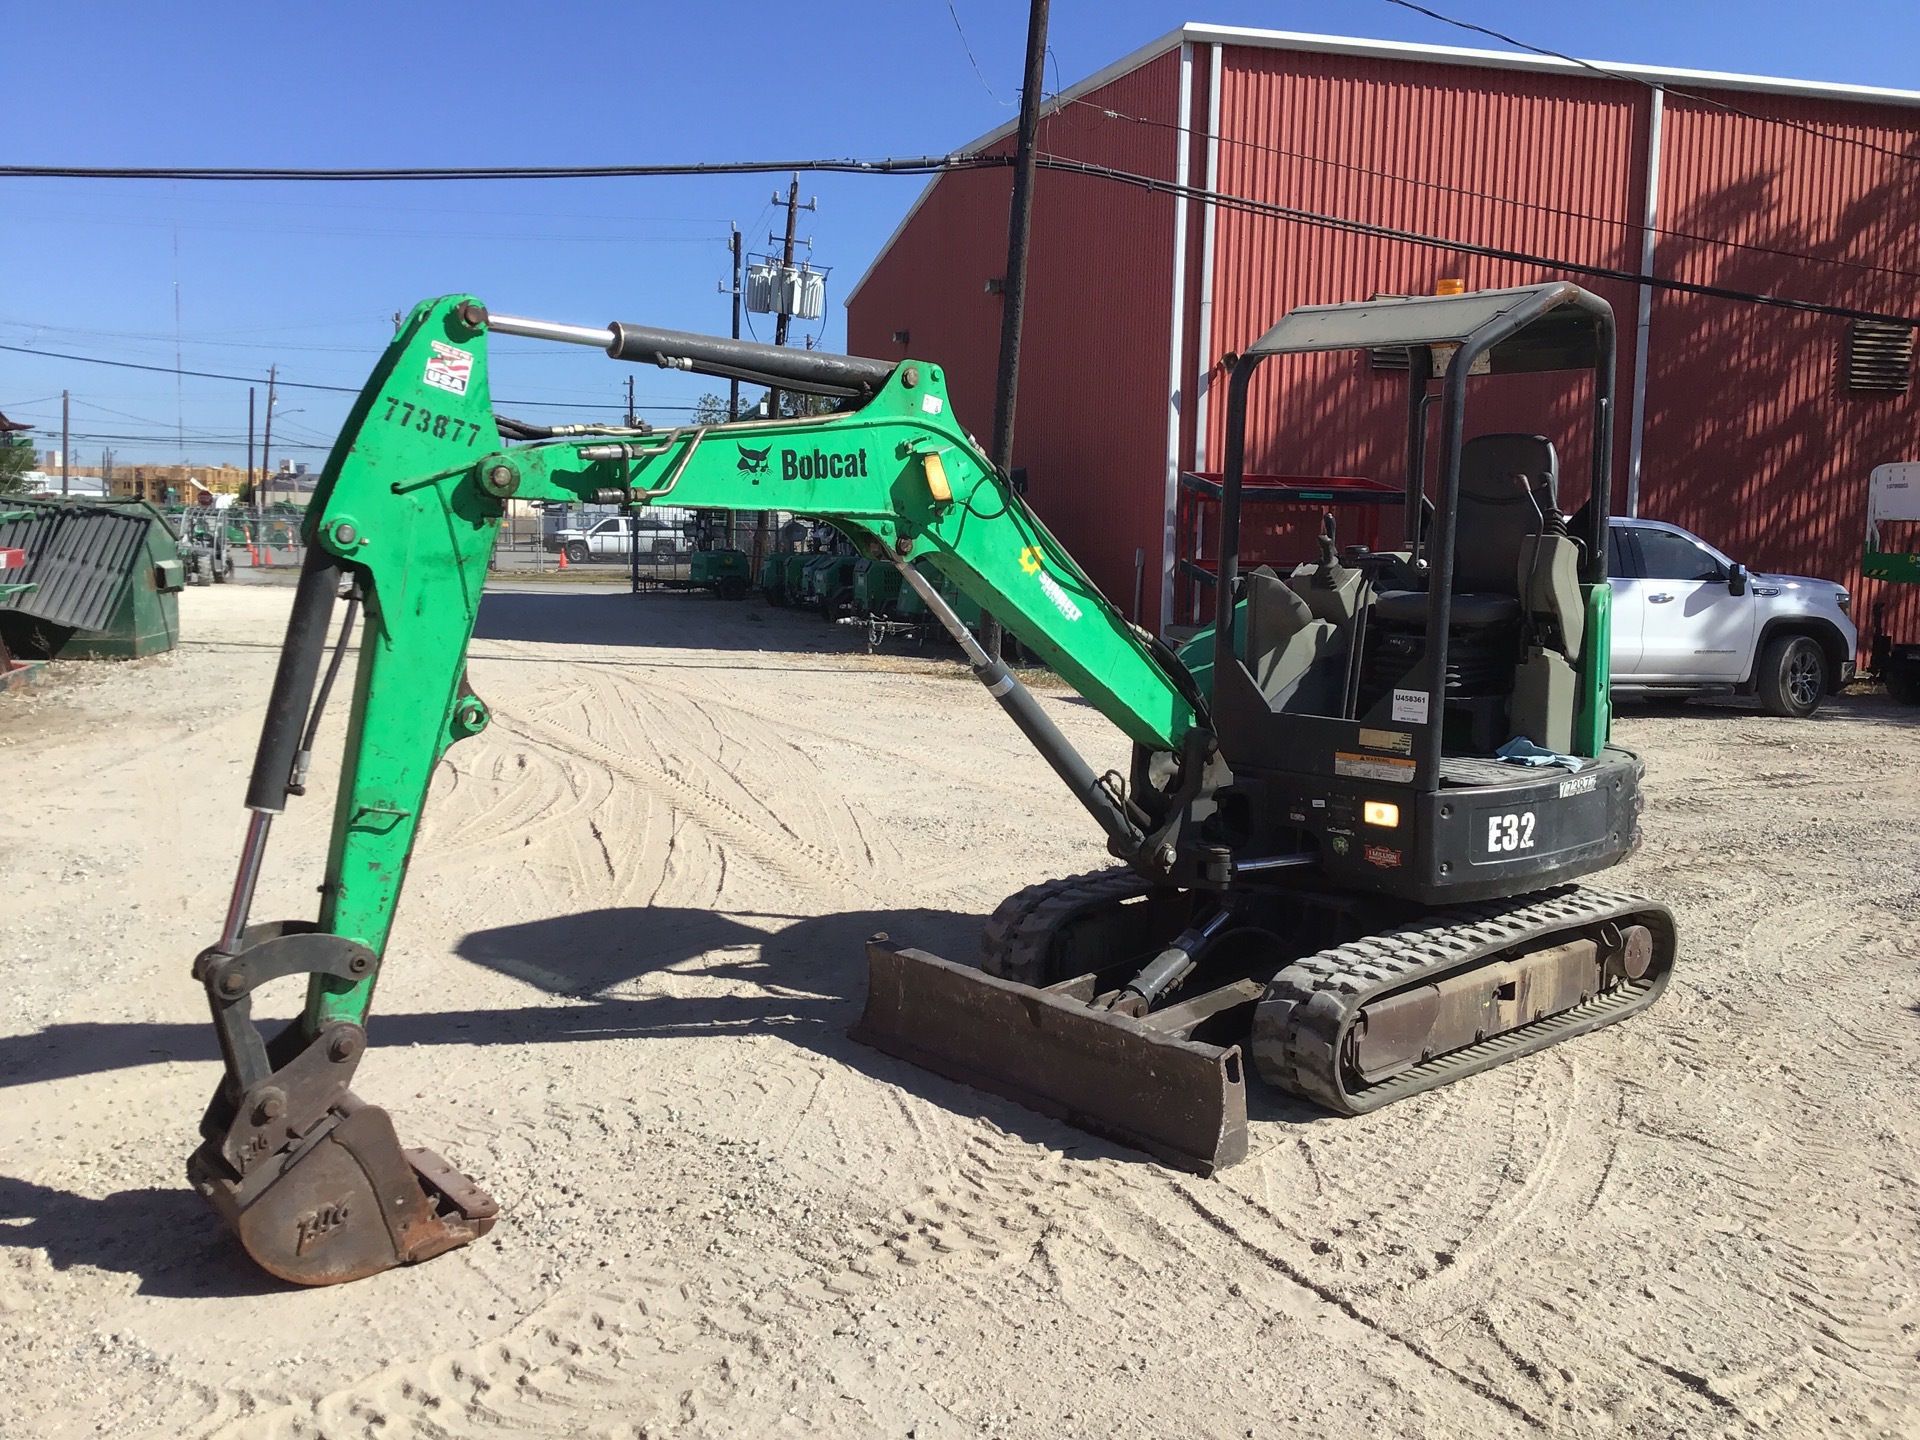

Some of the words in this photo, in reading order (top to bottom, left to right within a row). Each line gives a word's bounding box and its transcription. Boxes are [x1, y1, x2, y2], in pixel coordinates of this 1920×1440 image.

[427, 369, 464, 391] USA
[385, 396, 481, 447] 773877
[781, 448, 868, 480] Bobcat
[1039, 570, 1083, 622] SUNBELT
[1395, 694, 1426, 704] U458361
[1488, 811, 1536, 853] E32
[1372, 850, 1397, 860] MILLION
